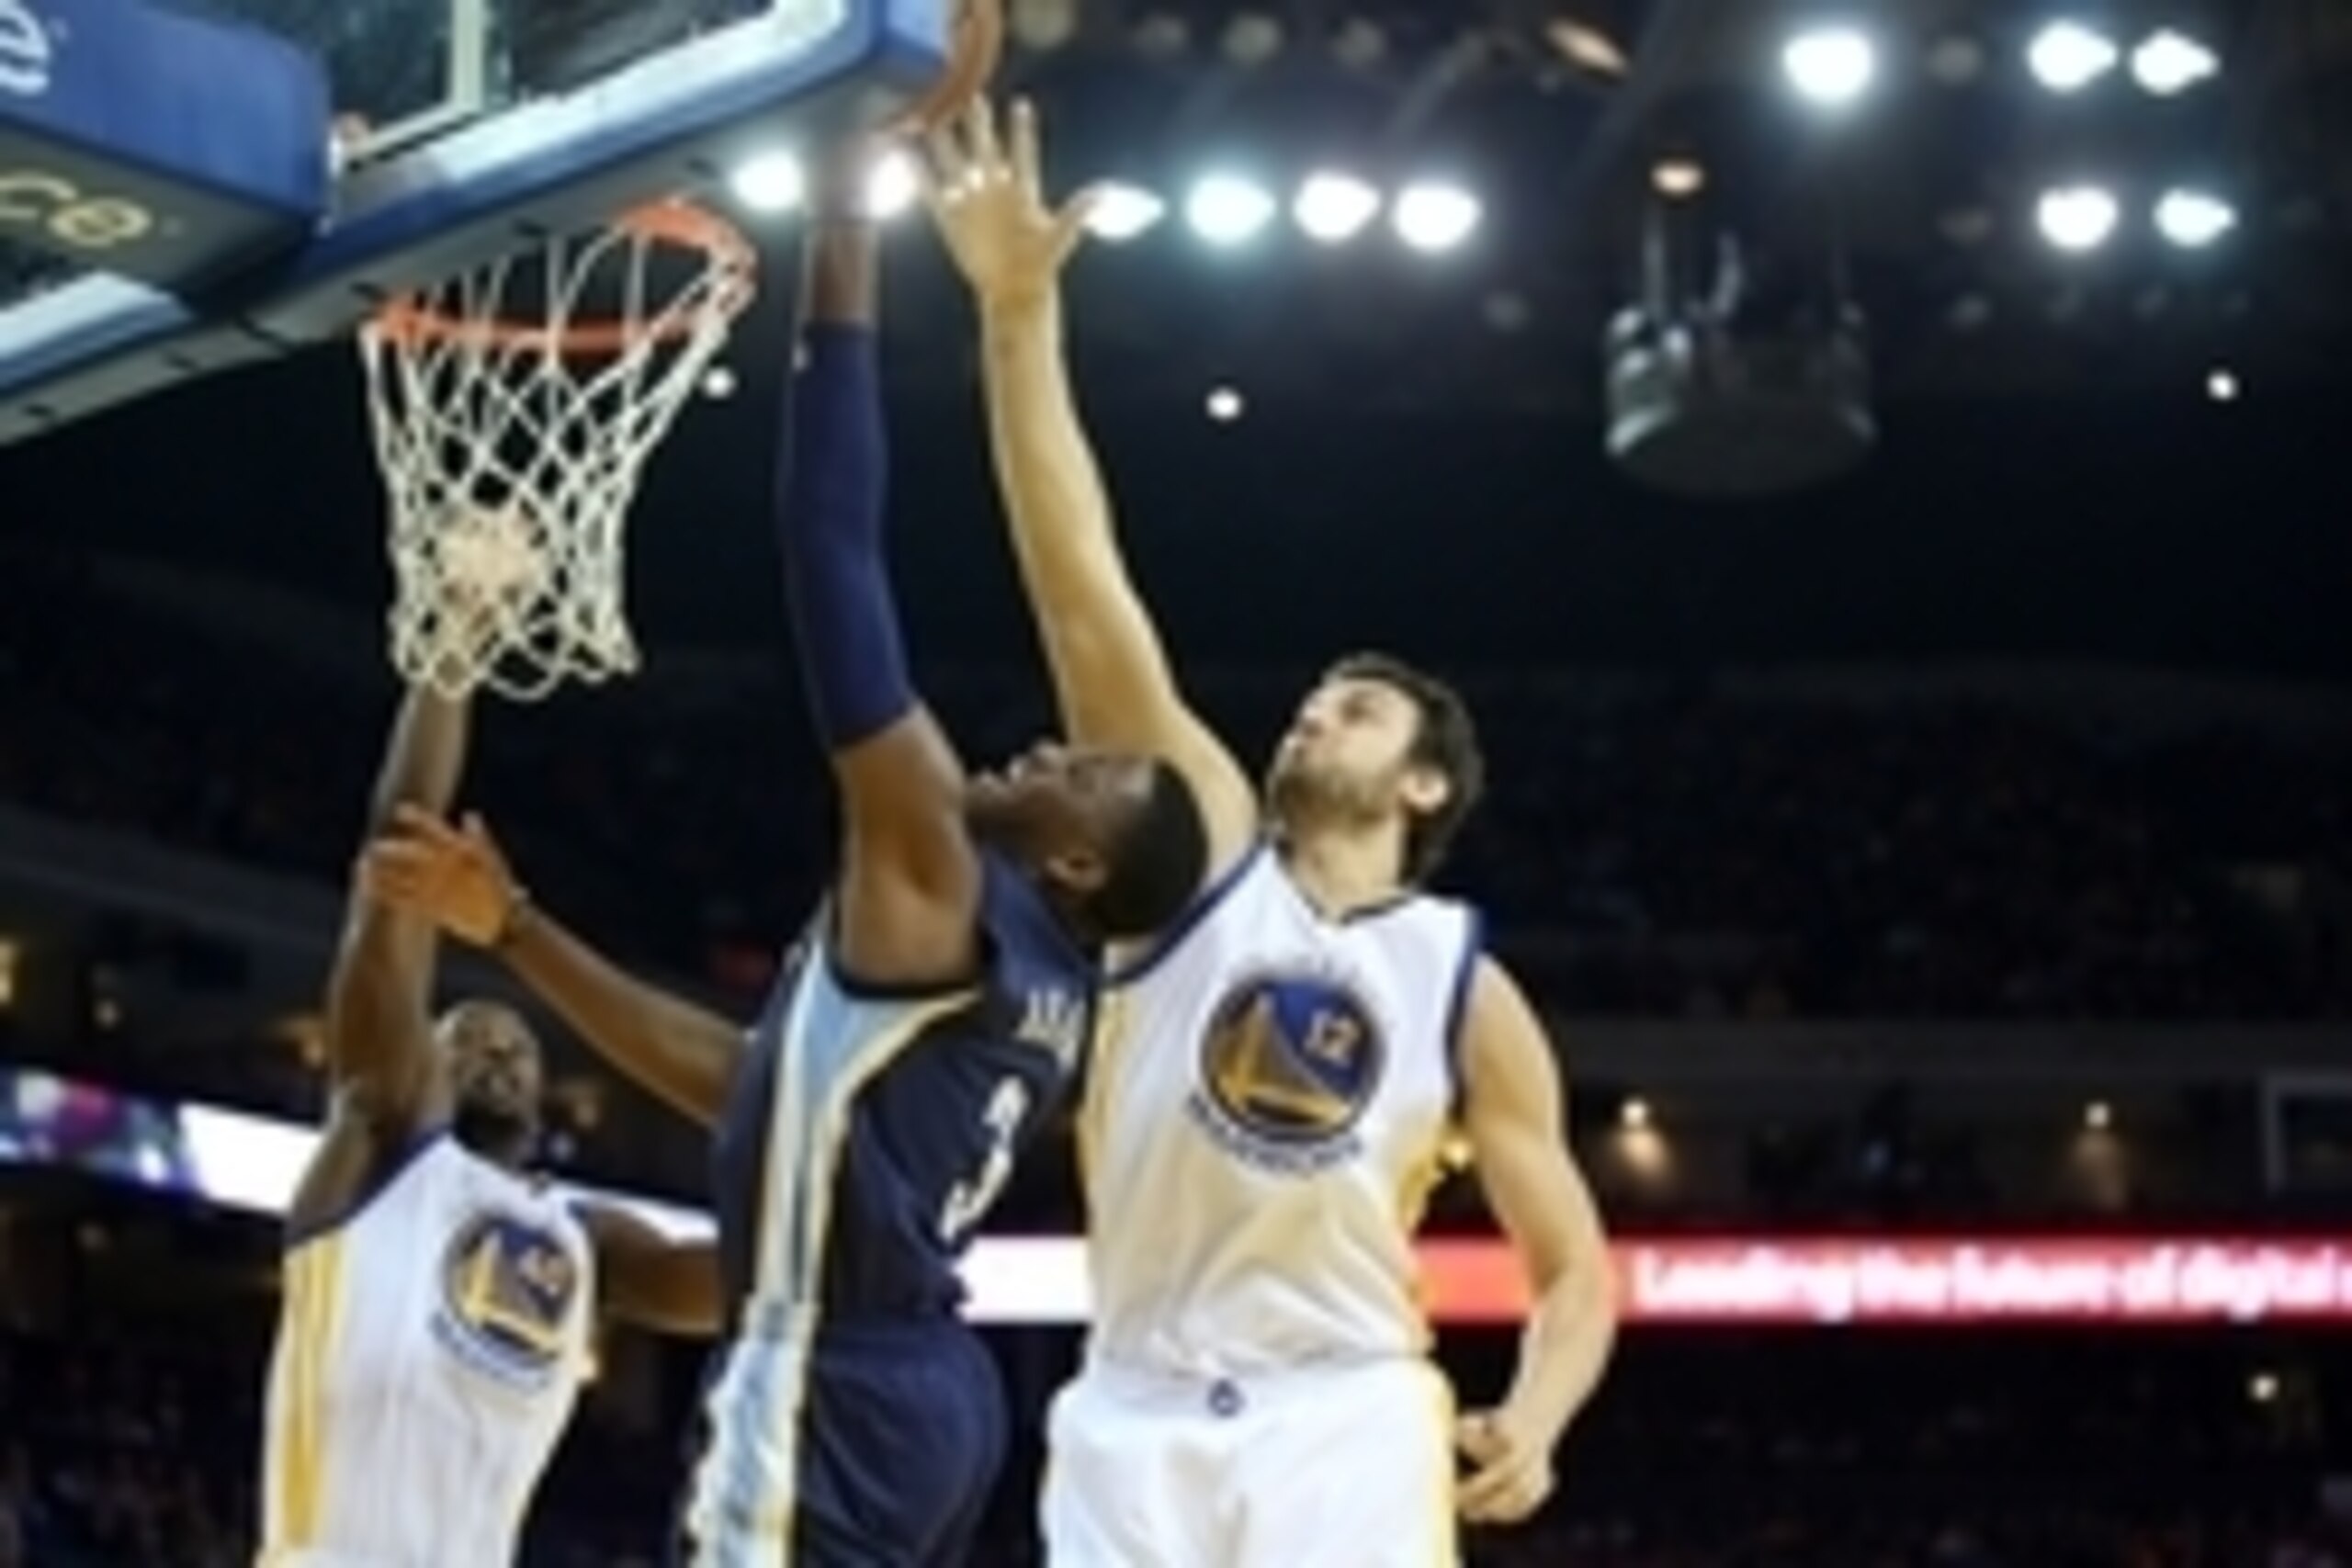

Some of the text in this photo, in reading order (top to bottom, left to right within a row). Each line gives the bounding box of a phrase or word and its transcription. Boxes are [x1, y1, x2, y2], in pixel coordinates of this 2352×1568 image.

[1633, 1246, 1851, 1322] Leading
[1858, 1246, 1946, 1314] the
[1953, 1246, 2109, 1315] future
[2121, 1246, 2181, 1315] of
[2177, 1246, 2335, 1322] digital
